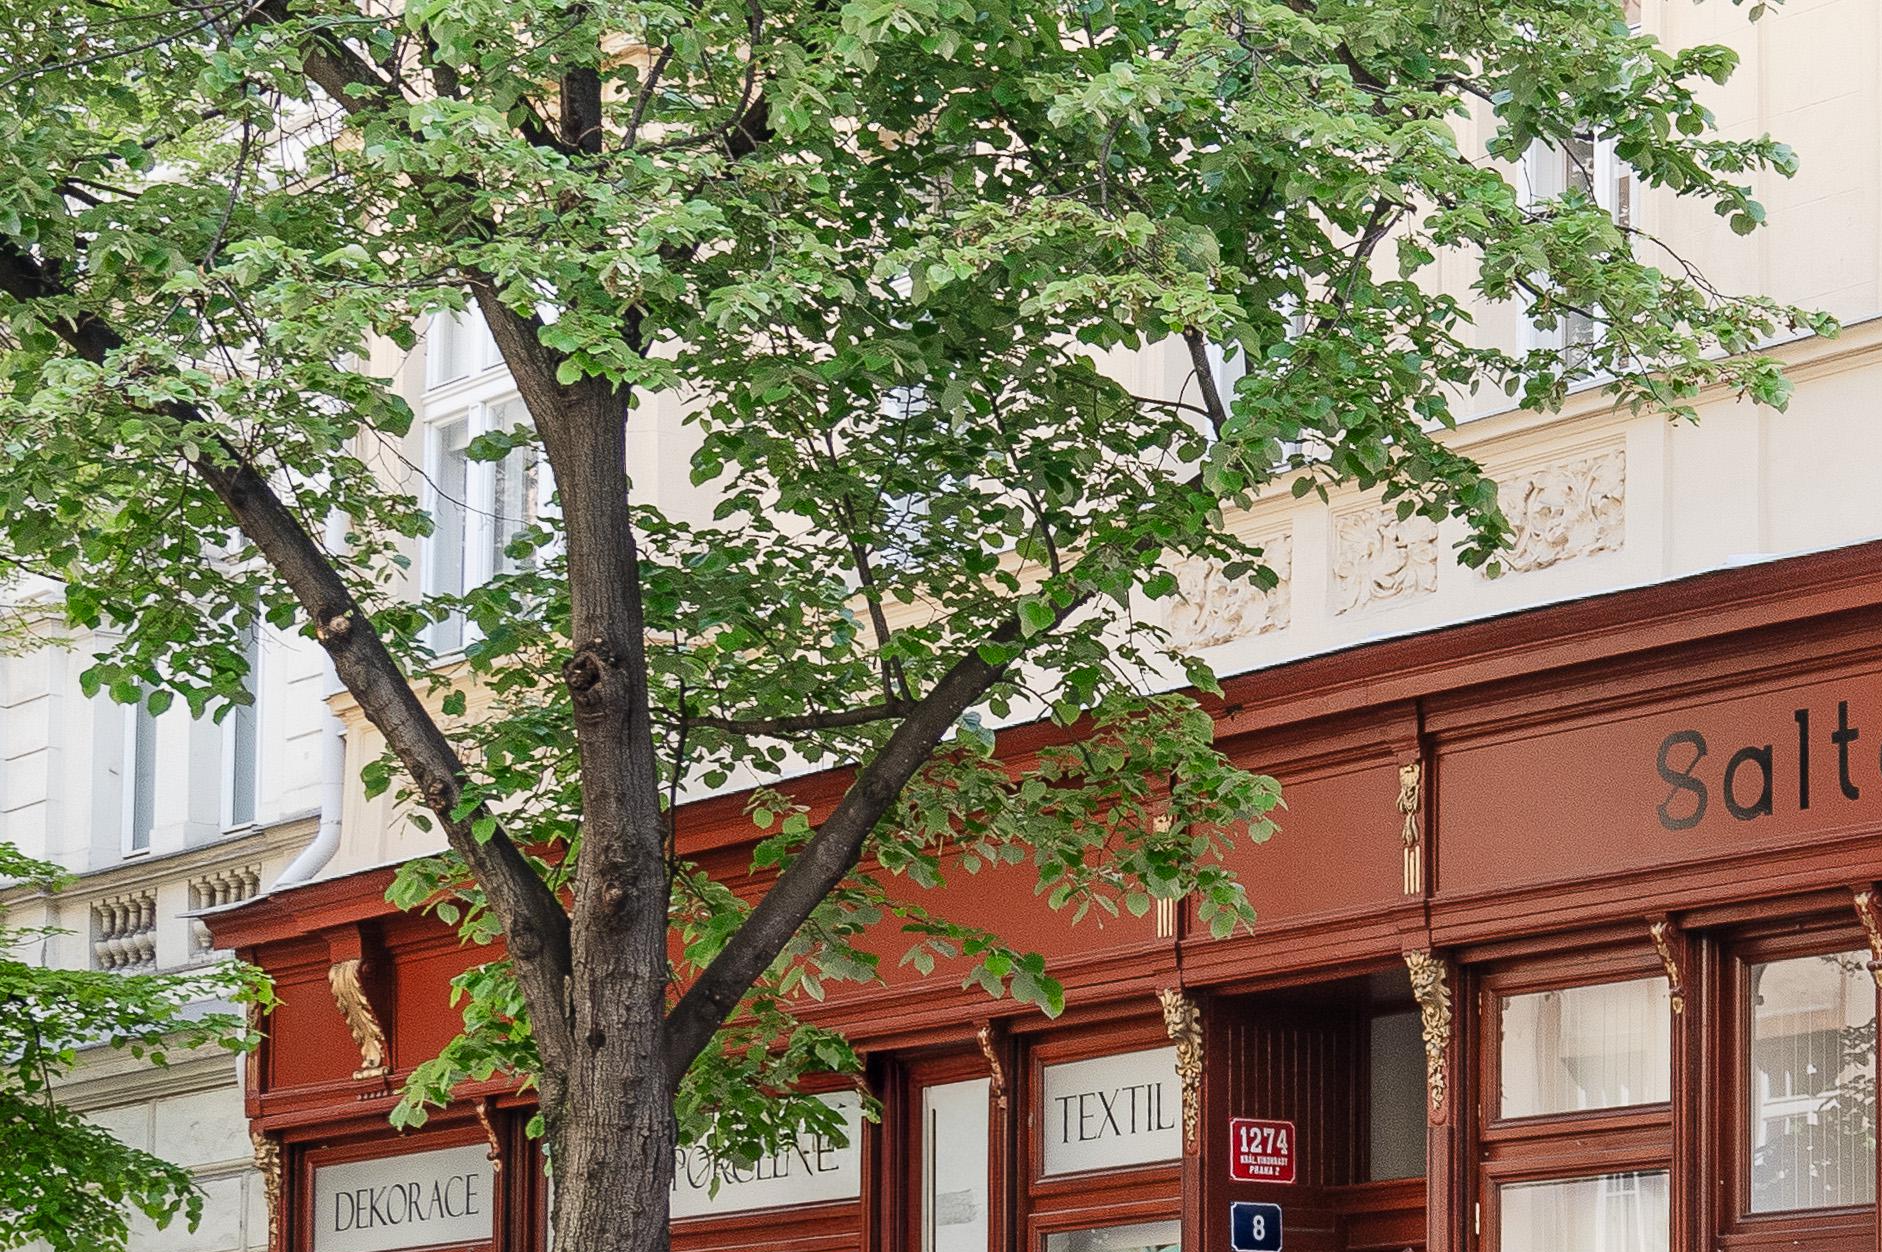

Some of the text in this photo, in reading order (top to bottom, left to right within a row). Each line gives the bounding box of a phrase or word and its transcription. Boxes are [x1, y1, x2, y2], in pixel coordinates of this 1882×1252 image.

[1054, 1081, 1176, 1145] TEXTIL
[1239, 1126, 1289, 1155] 1274
[334, 1173, 480, 1232] DEKORACE
[1252, 1214, 1265, 1241] 8
